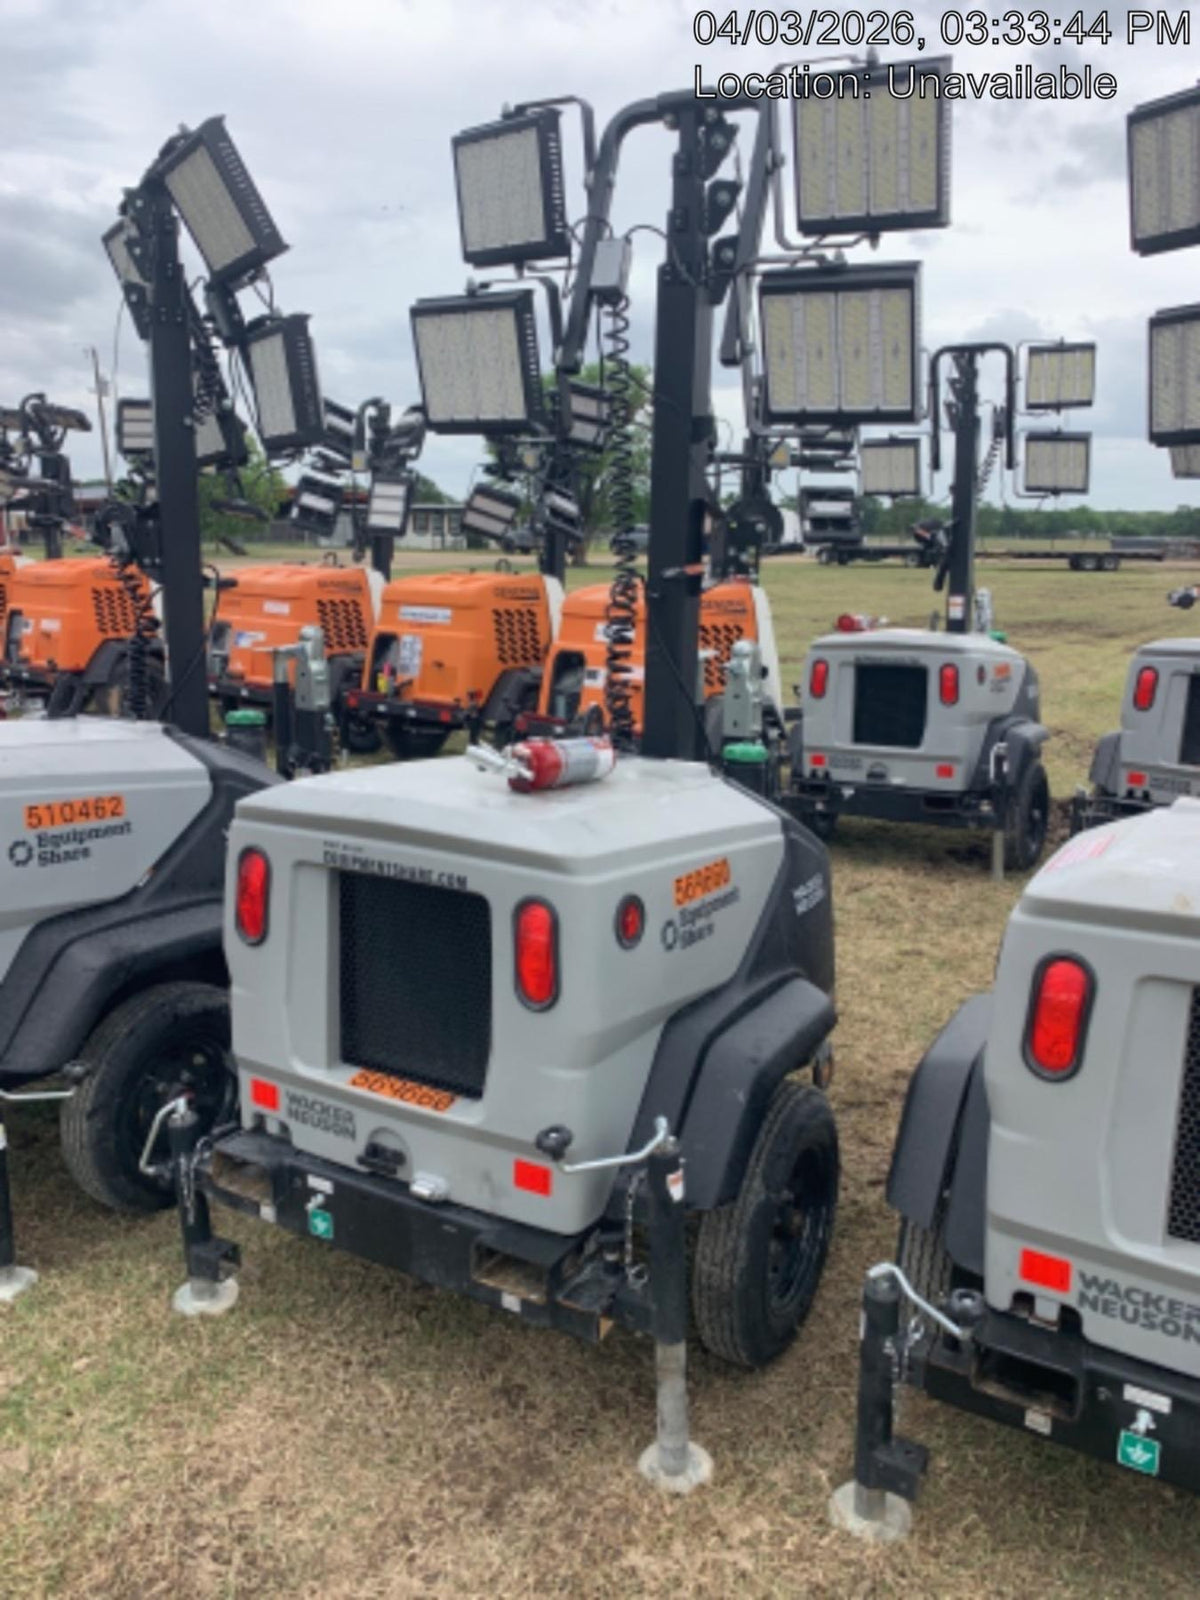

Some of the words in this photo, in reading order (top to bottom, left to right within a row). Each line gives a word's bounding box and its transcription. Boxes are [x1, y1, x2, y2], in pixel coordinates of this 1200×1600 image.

[26, 795, 124, 829] 510462
[37, 820, 133, 849] Equipment
[37, 846, 91, 868] Share
[285, 1088, 355, 1123] WACKER
[286, 1106, 357, 1142] NEUSON
[1078, 1269, 1200, 1324] WACKER
[1077, 1289, 1200, 1344] NEUSON
